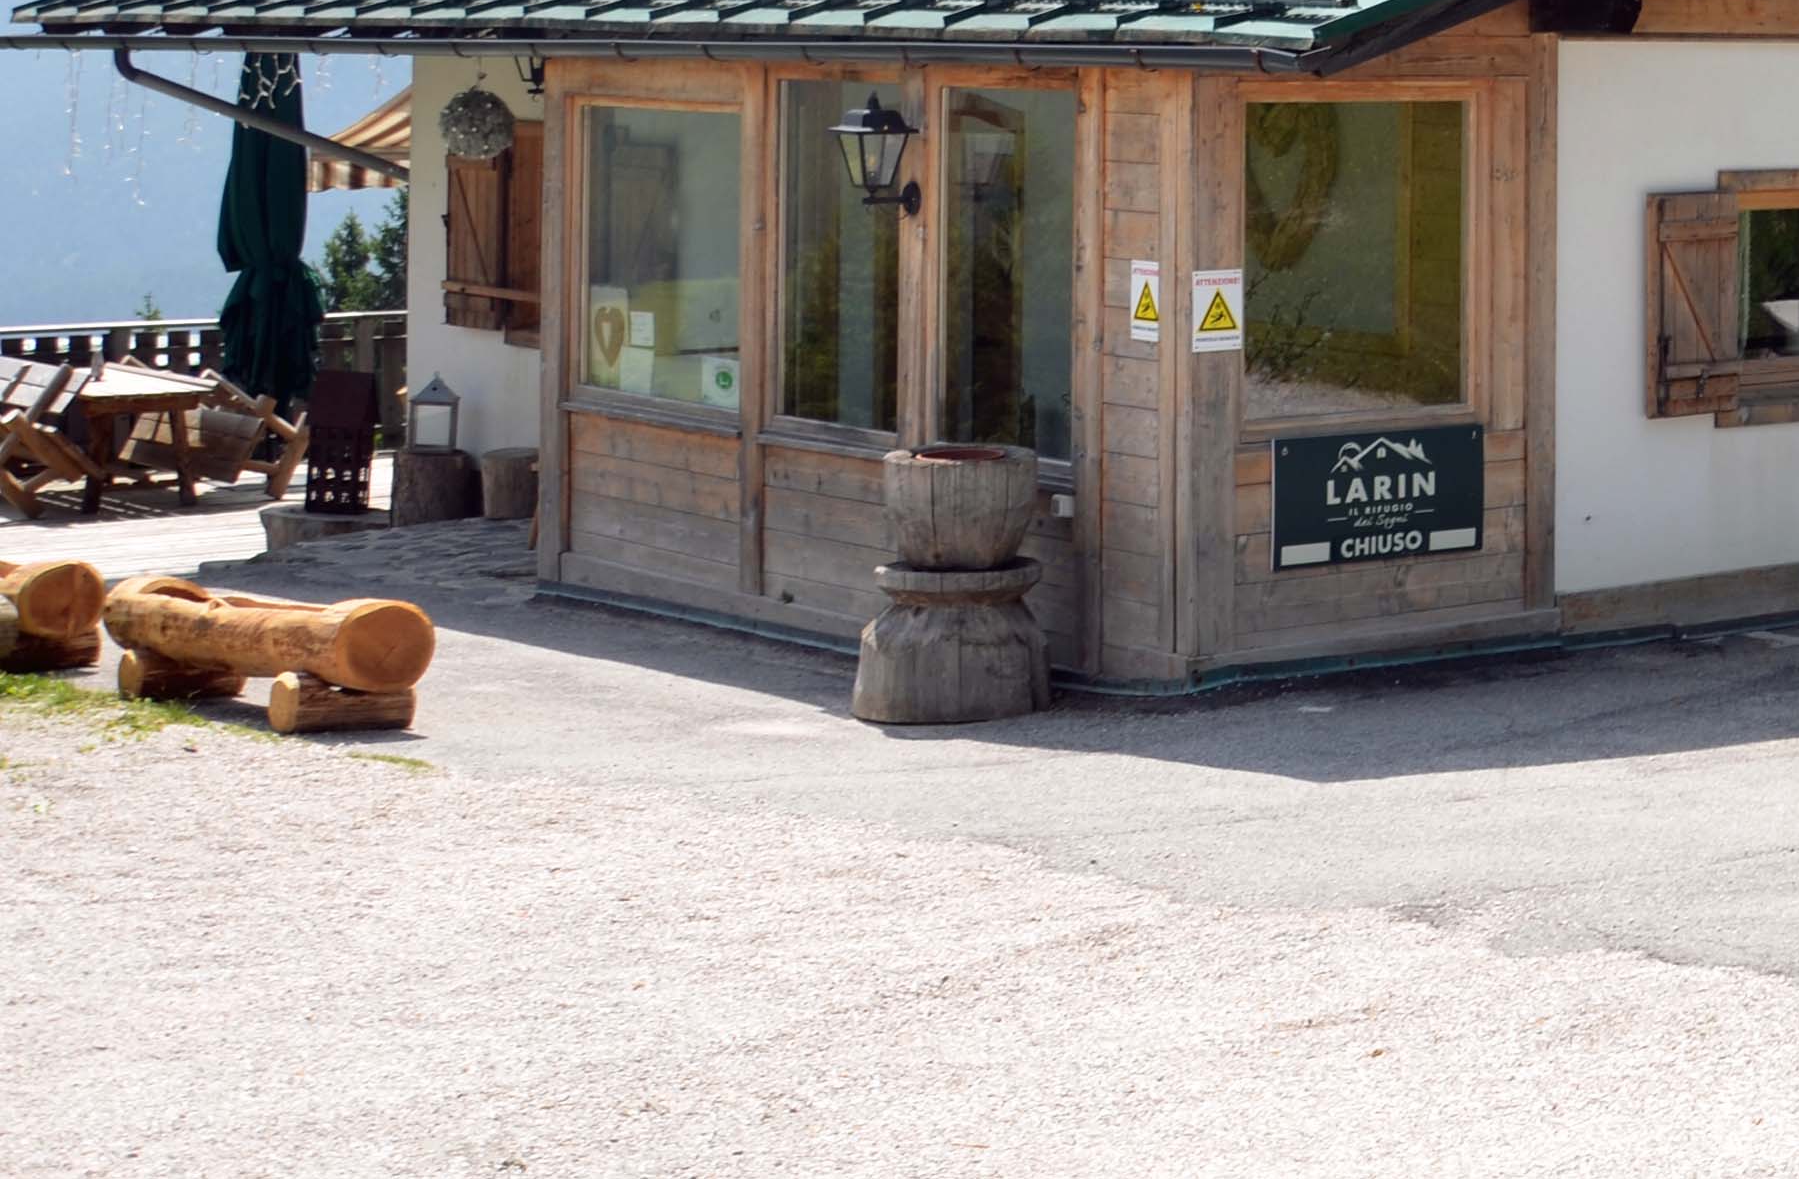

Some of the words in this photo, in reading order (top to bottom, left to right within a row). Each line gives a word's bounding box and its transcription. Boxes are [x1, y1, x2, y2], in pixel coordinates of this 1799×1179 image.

[1326, 471, 1435, 505] LARIN
[1364, 502, 1414, 515] RIFUGIO
[1340, 530, 1423, 559] CHIUSO
